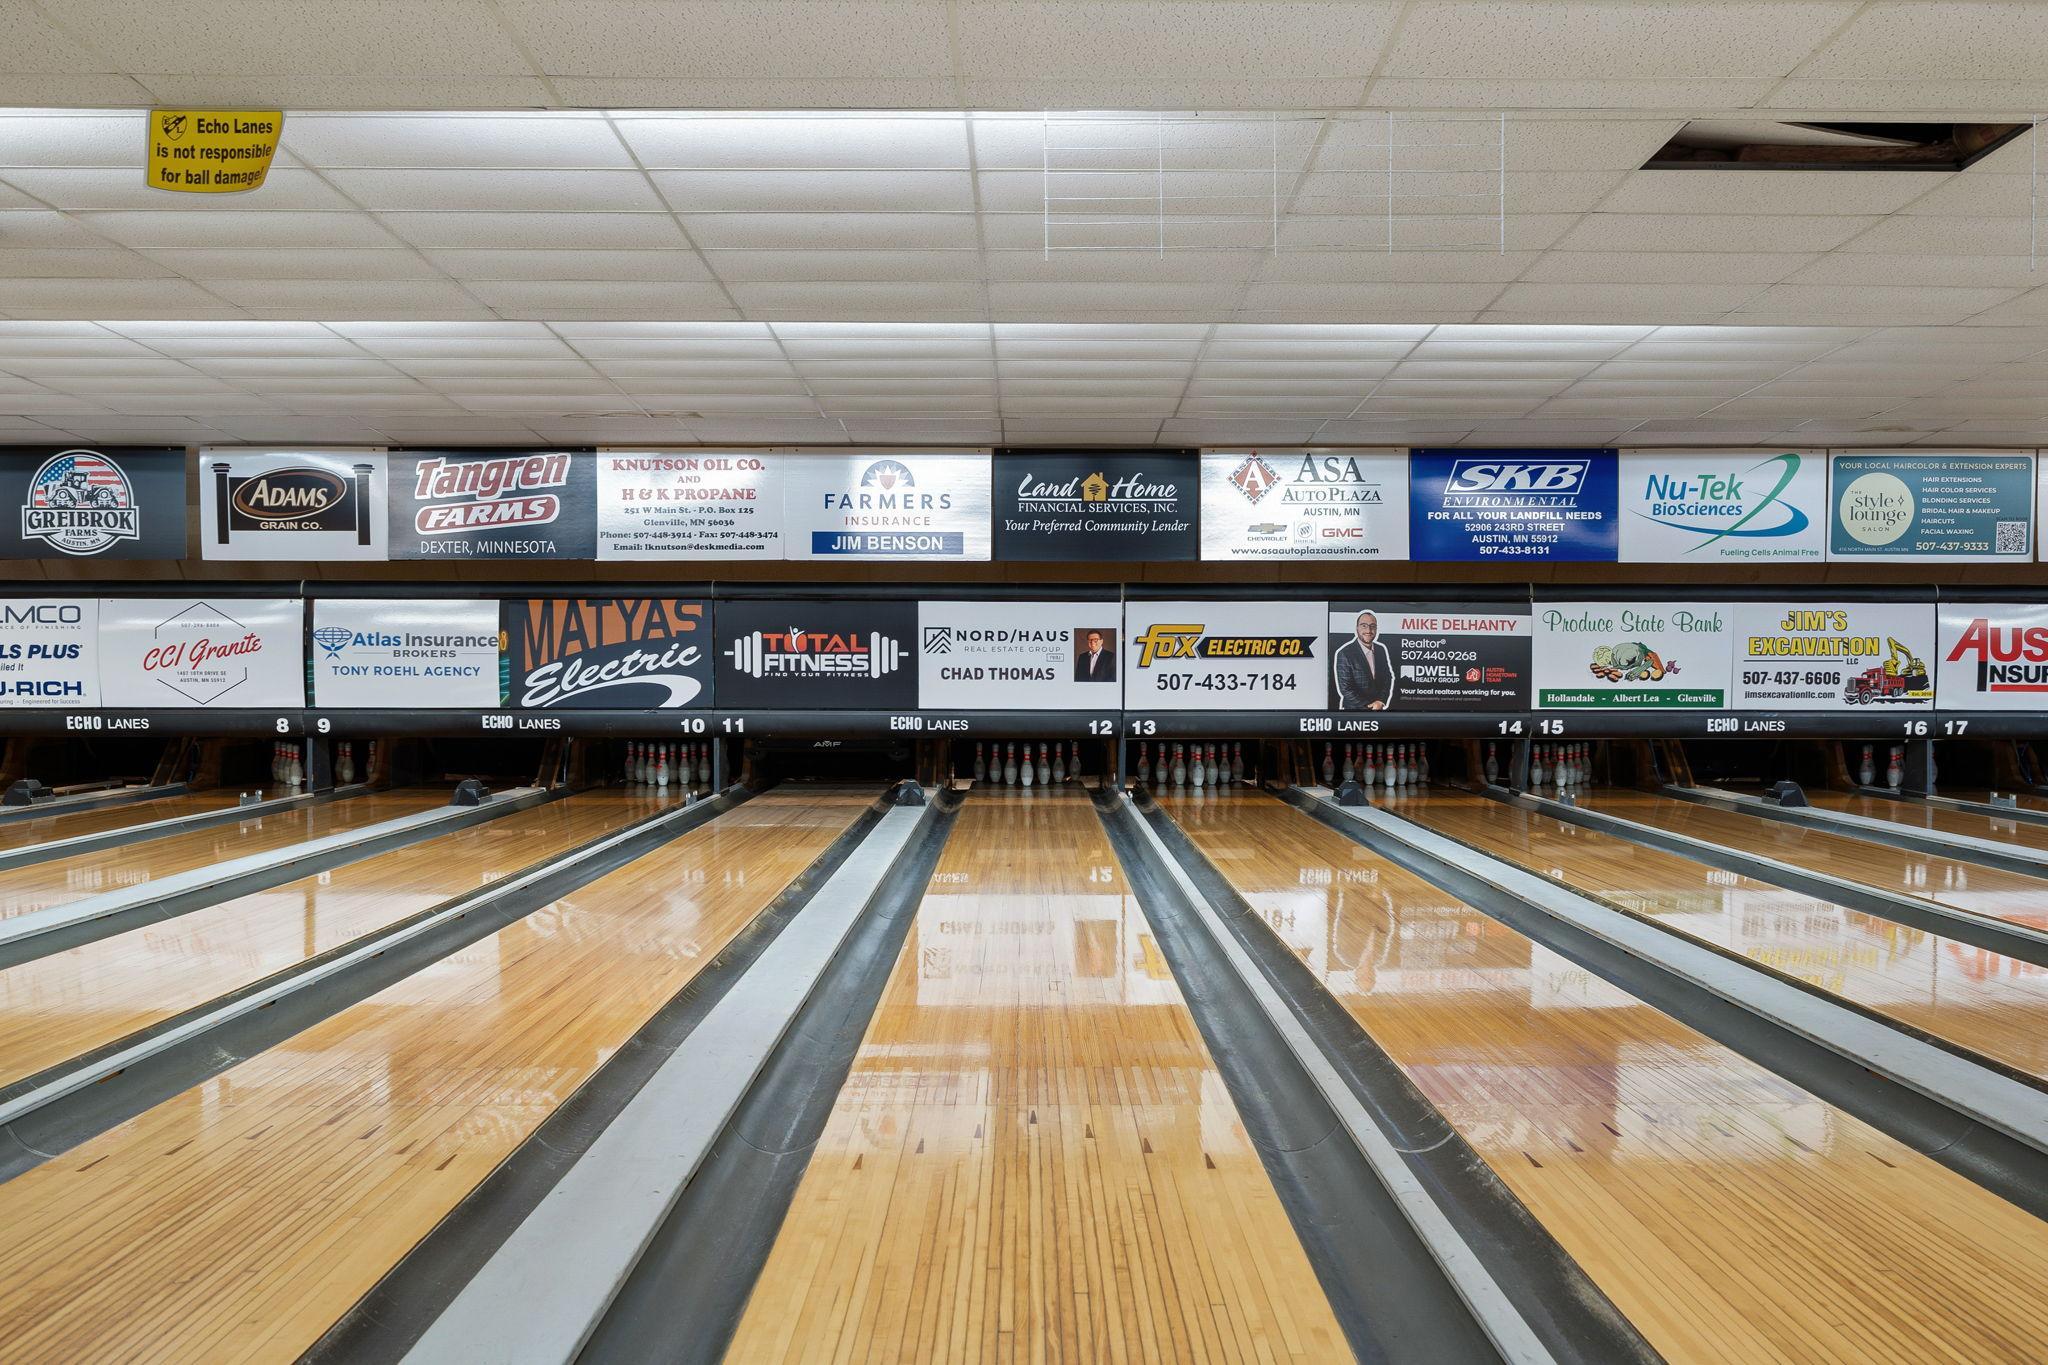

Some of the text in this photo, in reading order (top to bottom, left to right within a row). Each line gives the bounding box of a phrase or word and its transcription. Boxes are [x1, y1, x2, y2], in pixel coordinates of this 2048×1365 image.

[198, 119, 272, 133] Echo Lanes
[157, 143, 272, 162] is not responsible
[161, 167, 264, 185] for ball damage!
[612, 459, 765, 470] KNUTSON OIL CO.
[1294, 453, 1365, 482] ASA
[415, 453, 571, 500] Tangren
[1450, 465, 1584, 491] SKB
[1018, 473, 1177, 498] Land Home
[1645, 474, 1744, 500] Nu-Tek
[248, 478, 328, 508] ADAMS
[622, 488, 756, 500] H & K PROPANE
[825, 494, 951, 509] FARMERS
[1018, 503, 1177, 514] FINANCIAL SERVICES, INC.
[1443, 497, 1577, 506] ENVIRONMENTAL
[1855, 494, 1893, 510] style
[425, 500, 548, 528] FARMS
[1304, 508, 1360, 517] AUSTIN, MN
[1428, 512, 1602, 520] FOR ALL YOUR LANDFILL NEEDS
[1652, 502, 1742, 516] BioSciences
[1850, 506, 1906, 526] lounge
[28, 511, 133, 530] GREIBROK
[260, 521, 322, 530] GRAIN CO.
[644, 519, 687, 527] Glenville,
[846, 516, 930, 525] INSURANCE
[1005, 520, 1190, 534] Your Preferred Community Lender
[1465, 523, 1565, 531] 52906 243RD STREET
[1322, 528, 1363, 537] GMC
[1472, 535, 1557, 544] AUSTIN, MN 55912
[421, 541, 556, 555] DEXTER, MINNESOTA
[832, 536, 943, 550] JIM BENSON
[1916, 542, 1989, 551] 507-437-9333
[1232, 546, 1379, 556] www.asaautoplazaaustin.com
[1480, 546, 1550, 555] 507-433-8131
[1720, 549, 1750, 557] Fueling
[1402, 618, 1517, 631] MIKE DELHANTY
[1542, 610, 1723, 632] Produce State Bank
[1781, 610, 1848, 631] JIM'S
[352, 632, 498, 647] Atlas Insurance
[524, 600, 702, 672] MATYAS
[956, 629, 1069, 643] NORD/HAUS
[763, 634, 868, 653] TOTAL
[1207, 640, 1277, 655] ELECTRIC
[1280, 640, 1304, 655] CO.
[1748, 637, 1880, 656] EXCAVATION
[144, 633, 262, 671] CCI Granite
[393, 650, 456, 658] BROKERS
[1401, 651, 1477, 661] 507.440.9268
[764, 654, 868, 671] FITNESS
[332, 666, 480, 676] TONY ROEHL AGENCY
[521, 643, 702, 707] Electric
[941, 668, 1055, 680] CHAD THOMAS
[1416, 666, 1459, 676] DWELL
[1743, 671, 1841, 685] 507-437-6606
[1157, 673, 1296, 691] 507-433-7184
[1548, 694, 1716, 702] Hollandale Albert Lea Glenville
[1744, 691, 1835, 700] jimsexcavationllc.com
[66, 716, 149, 729] ECHO LANES
[276, 718, 289, 733] 8
[317, 718, 330, 733] 9
[482, 715, 561, 729] ECHO LANES
[681, 719, 704, 733] 10
[722, 718, 744, 732] 11
[890, 717, 969, 730] ECHO LANES
[1089, 720, 1112, 735] 12
[1132, 720, 1156, 735] 13
[1300, 718, 1379, 731] ECHO LANES
[1498, 721, 1522, 734] 14
[1540, 720, 1564, 734] 15
[1707, 718, 1786, 732] ECHO LANES
[1904, 721, 1928, 736] 16
[1944, 721, 1968, 734] 17
